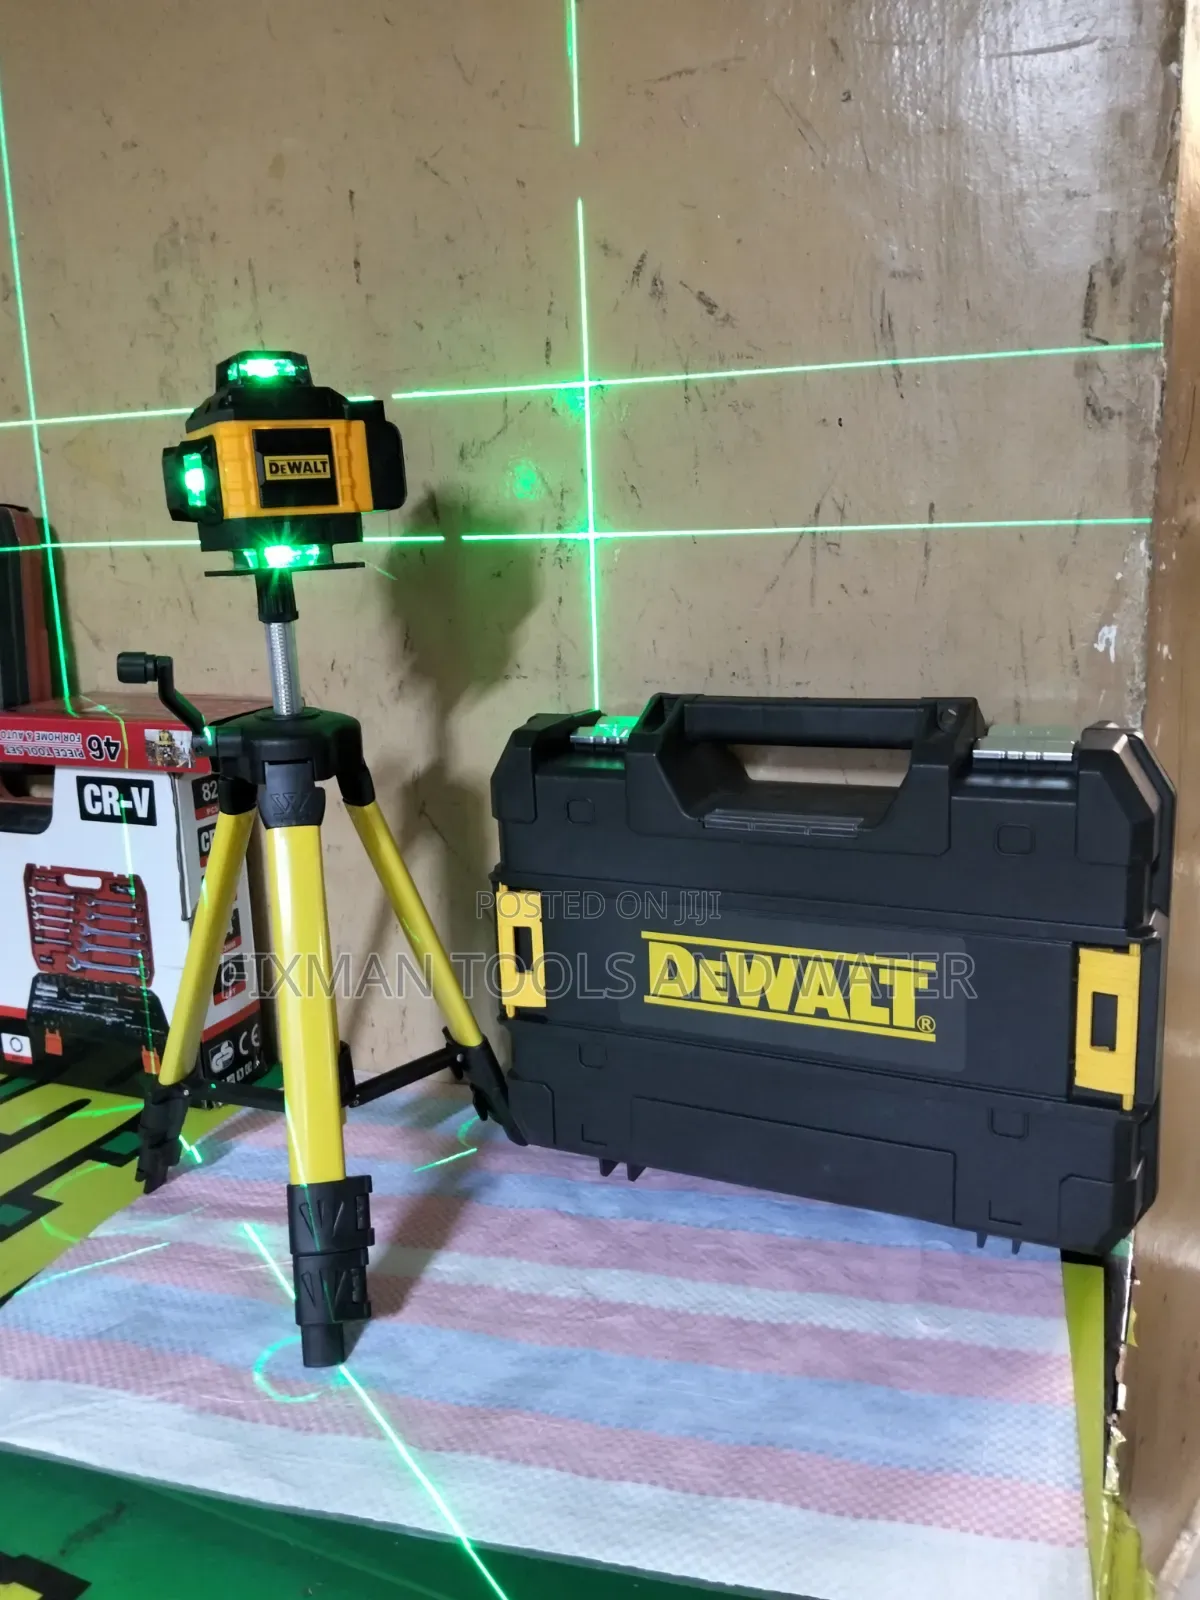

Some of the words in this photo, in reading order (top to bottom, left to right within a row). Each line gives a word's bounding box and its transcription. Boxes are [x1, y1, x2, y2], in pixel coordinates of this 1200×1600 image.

[35, 731, 62, 742] HOME
[62, 733, 82, 743] FOR
[4, 744, 24, 755] SET
[25, 745, 54, 757] TOOL
[54, 747, 86, 759] PIECE
[87, 734, 121, 761] 46
[201, 780, 219, 802] 82
[83, 783, 150, 818] CR-V
